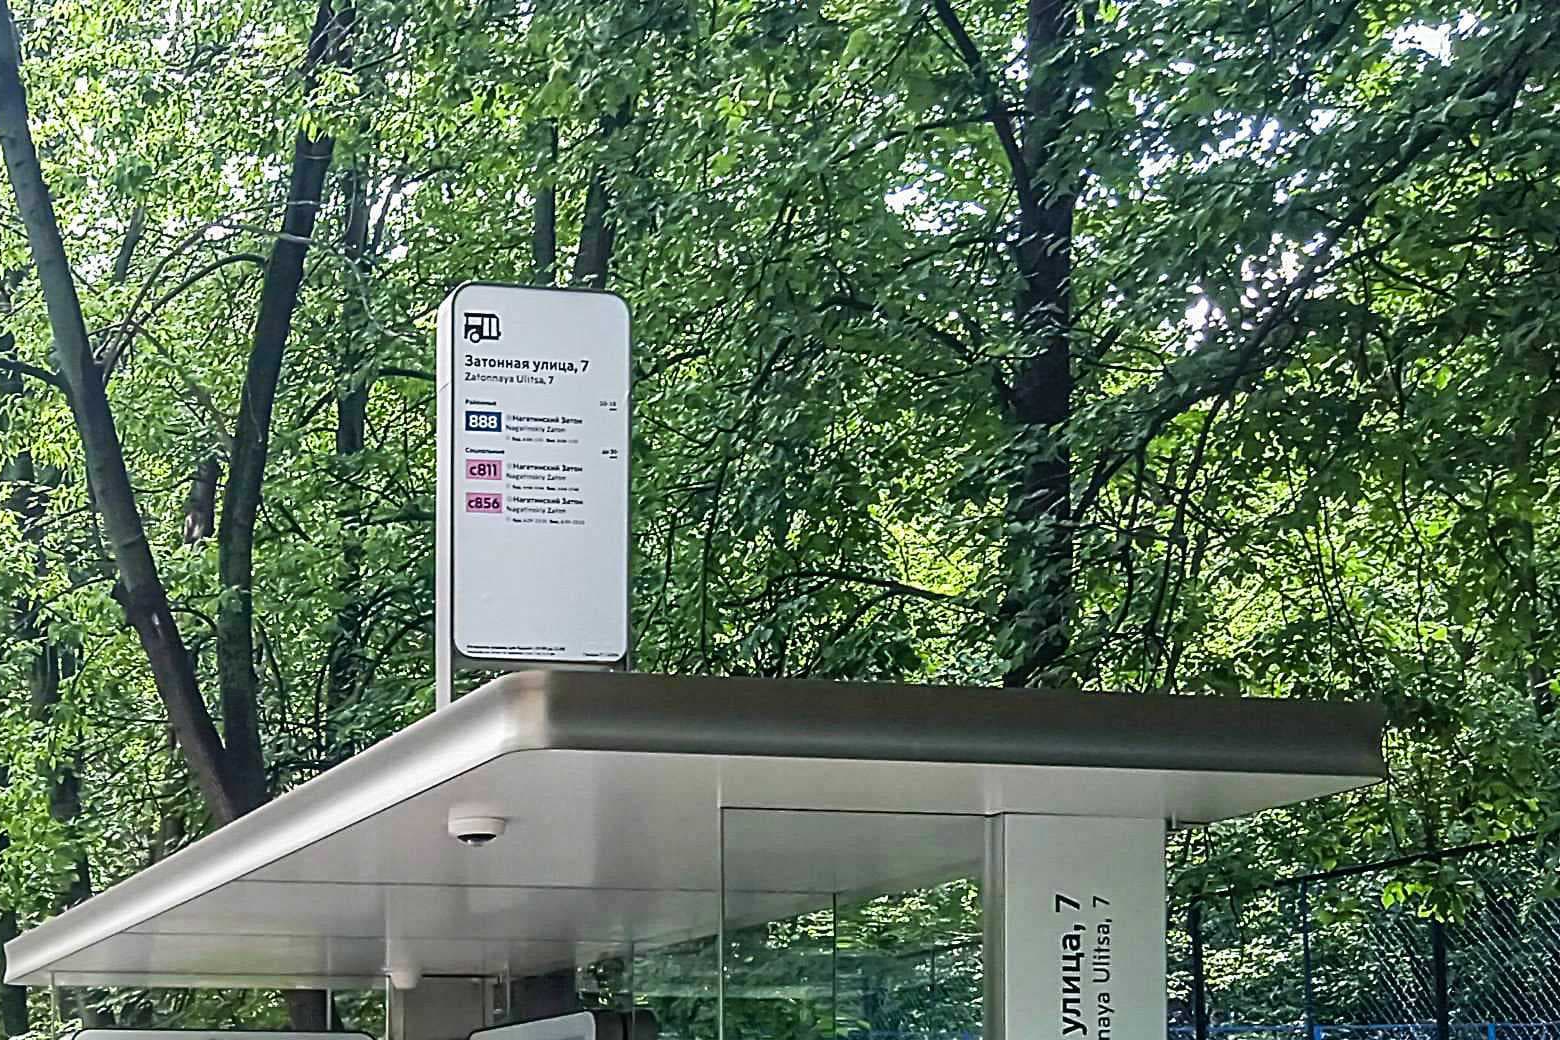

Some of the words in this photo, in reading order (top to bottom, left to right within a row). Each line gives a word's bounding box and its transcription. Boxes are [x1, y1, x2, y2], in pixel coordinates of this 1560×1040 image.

[464, 354, 530, 370] Затонная
[532, 359, 578, 374] улица,
[580, 359, 590, 372] 7
[547, 375, 554, 384] 7
[468, 414, 498, 429] 888
[469, 463, 497, 477] с811
[468, 497, 500, 510] с856
[1055, 893, 1080, 912] 7
[1092, 895, 1110, 908] 7
[1092, 918, 1112, 983] Ulitsa,
[1062, 924, 1087, 1035] улица,
